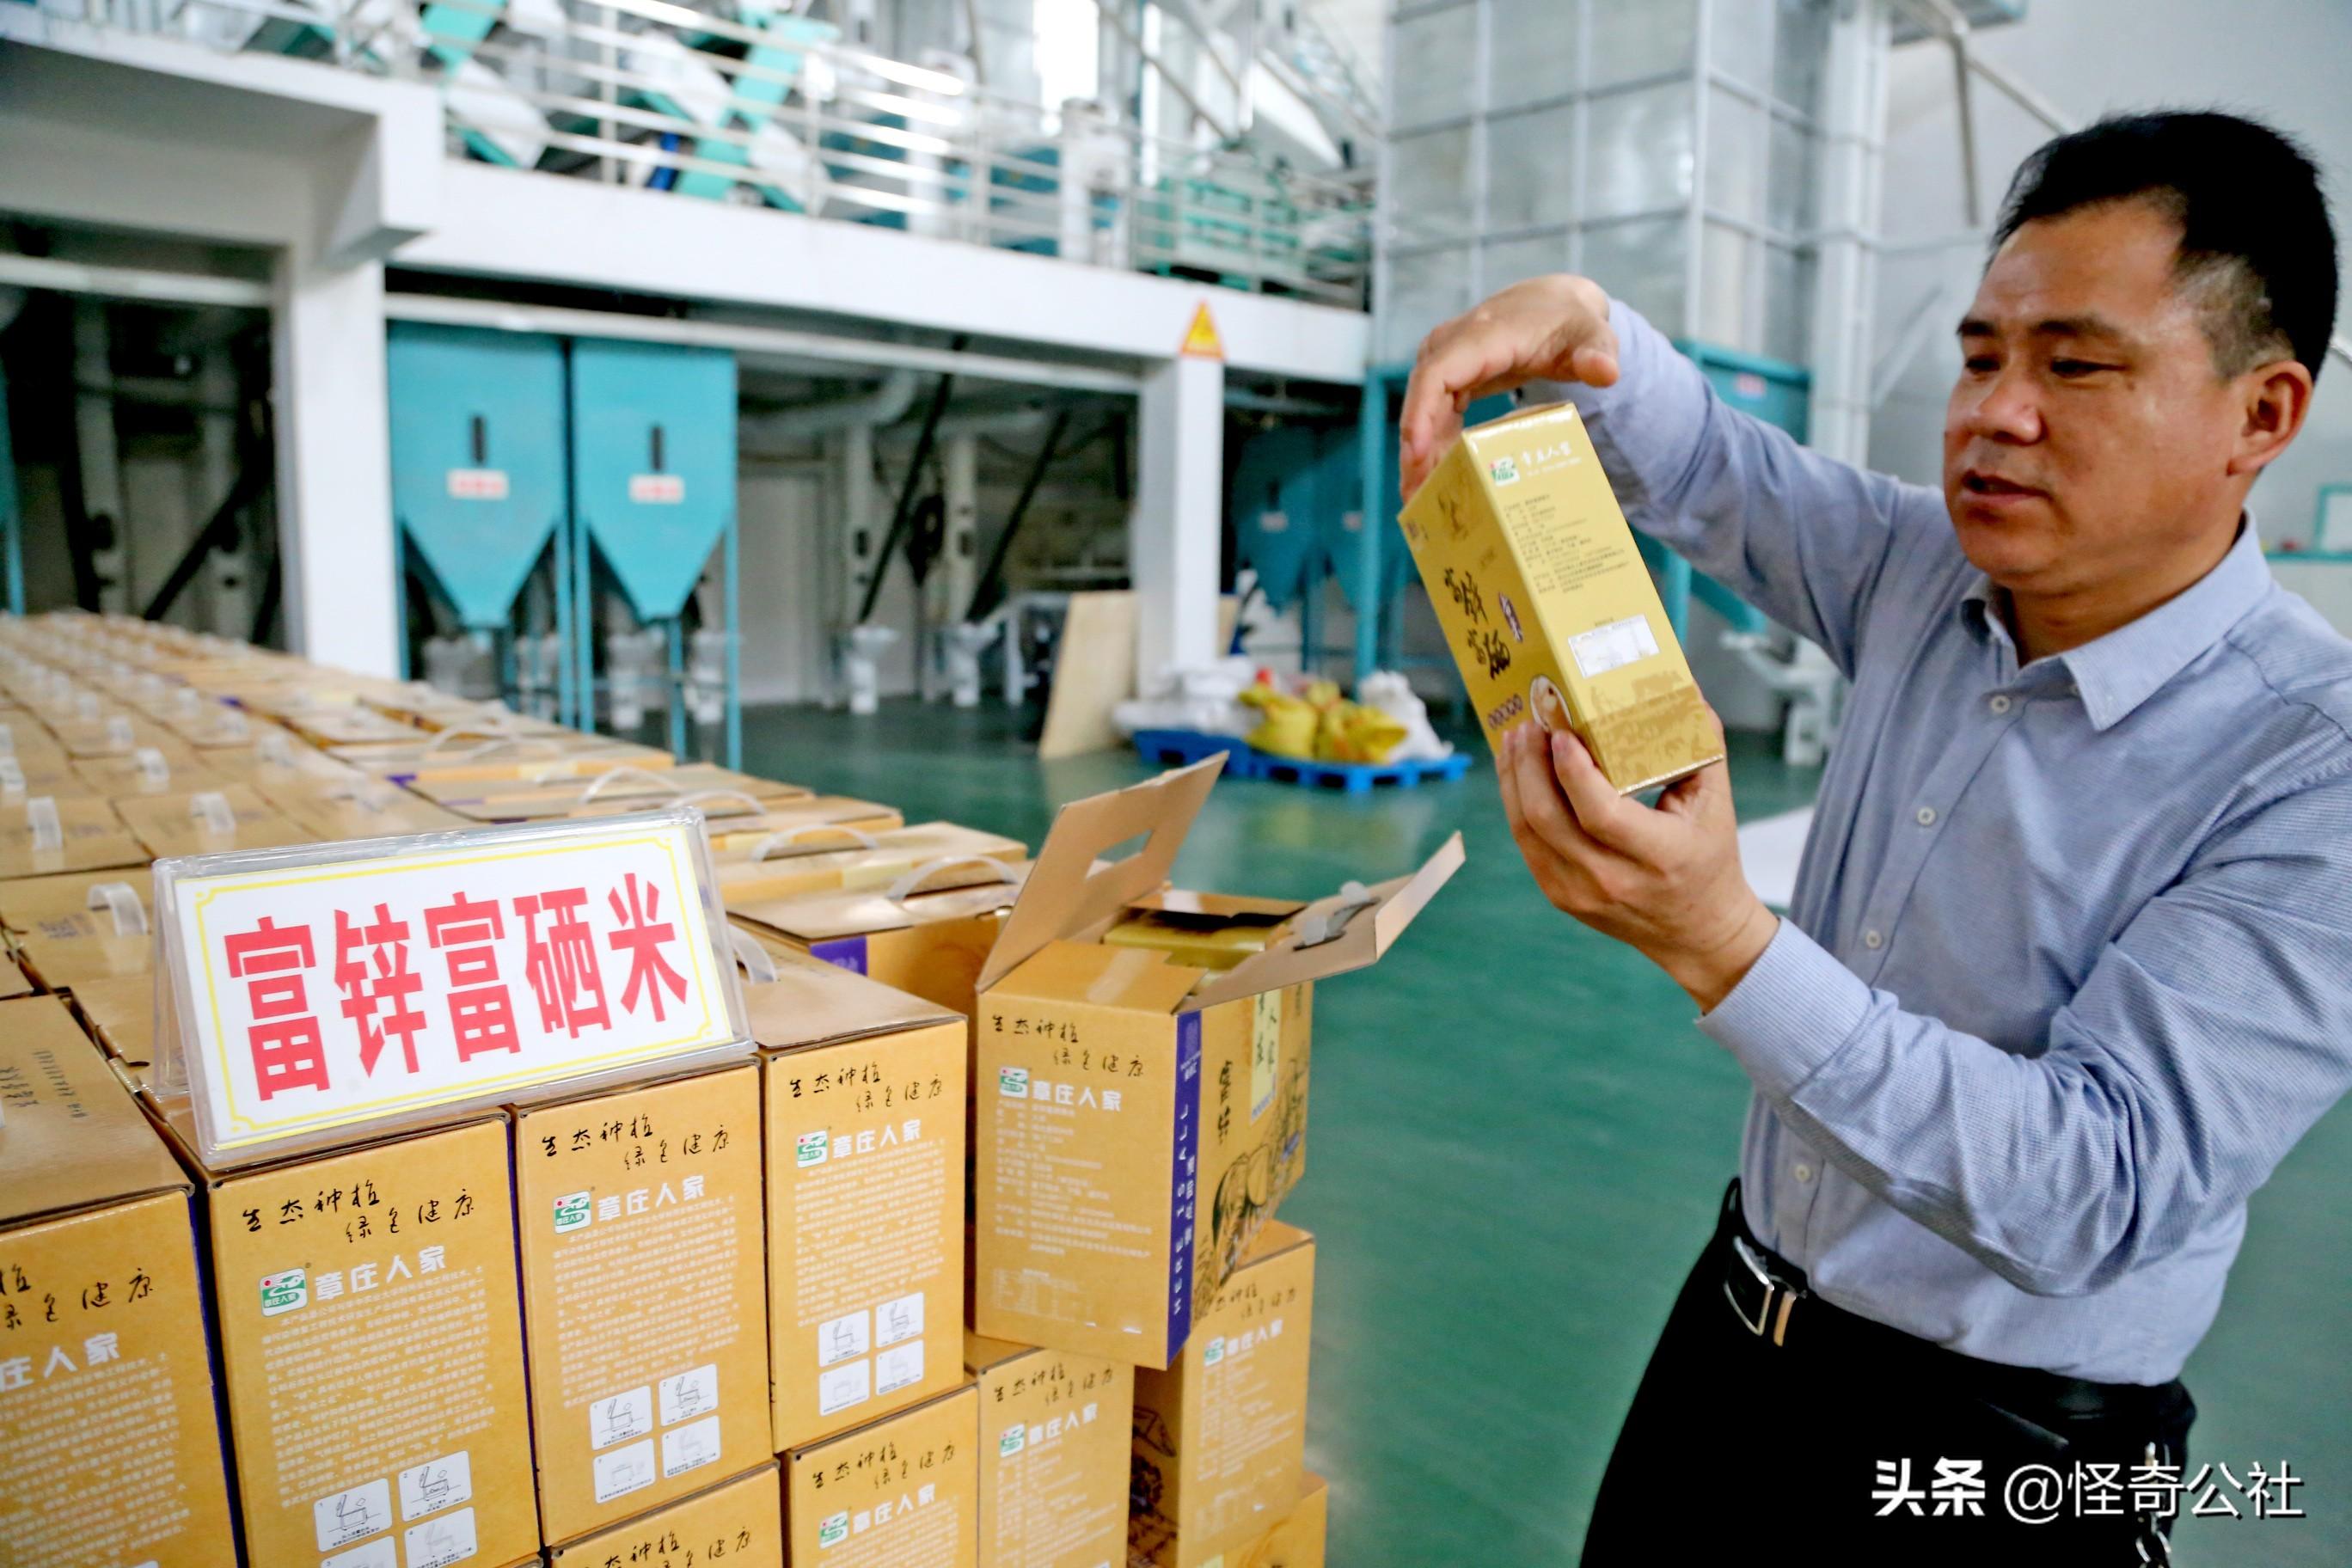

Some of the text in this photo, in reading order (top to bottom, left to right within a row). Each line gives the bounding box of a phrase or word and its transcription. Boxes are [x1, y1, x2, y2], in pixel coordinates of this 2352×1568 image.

[224, 873, 688, 1101] 富锌富硒米
[992, 1015, 1079, 1044] 生态种植
[789, 1061, 881, 1098] 生态种植
[855, 1073, 942, 1112] 绿色健康
[1032, 1080, 1122, 1112] 章庄人家
[541, 1113, 653, 1157] 生态种植
[624, 1124, 730, 1171] 绿色健康
[833, 1119, 922, 1159] 章庄人家
[242, 1179, 380, 1233] 生态种植
[346, 1189, 475, 1244] 绿色健康
[597, 1175, 705, 1222] 章庄人家
[315, 1245, 447, 1302] 章庄人家
[812, 1442, 897, 1489] 生态种植
